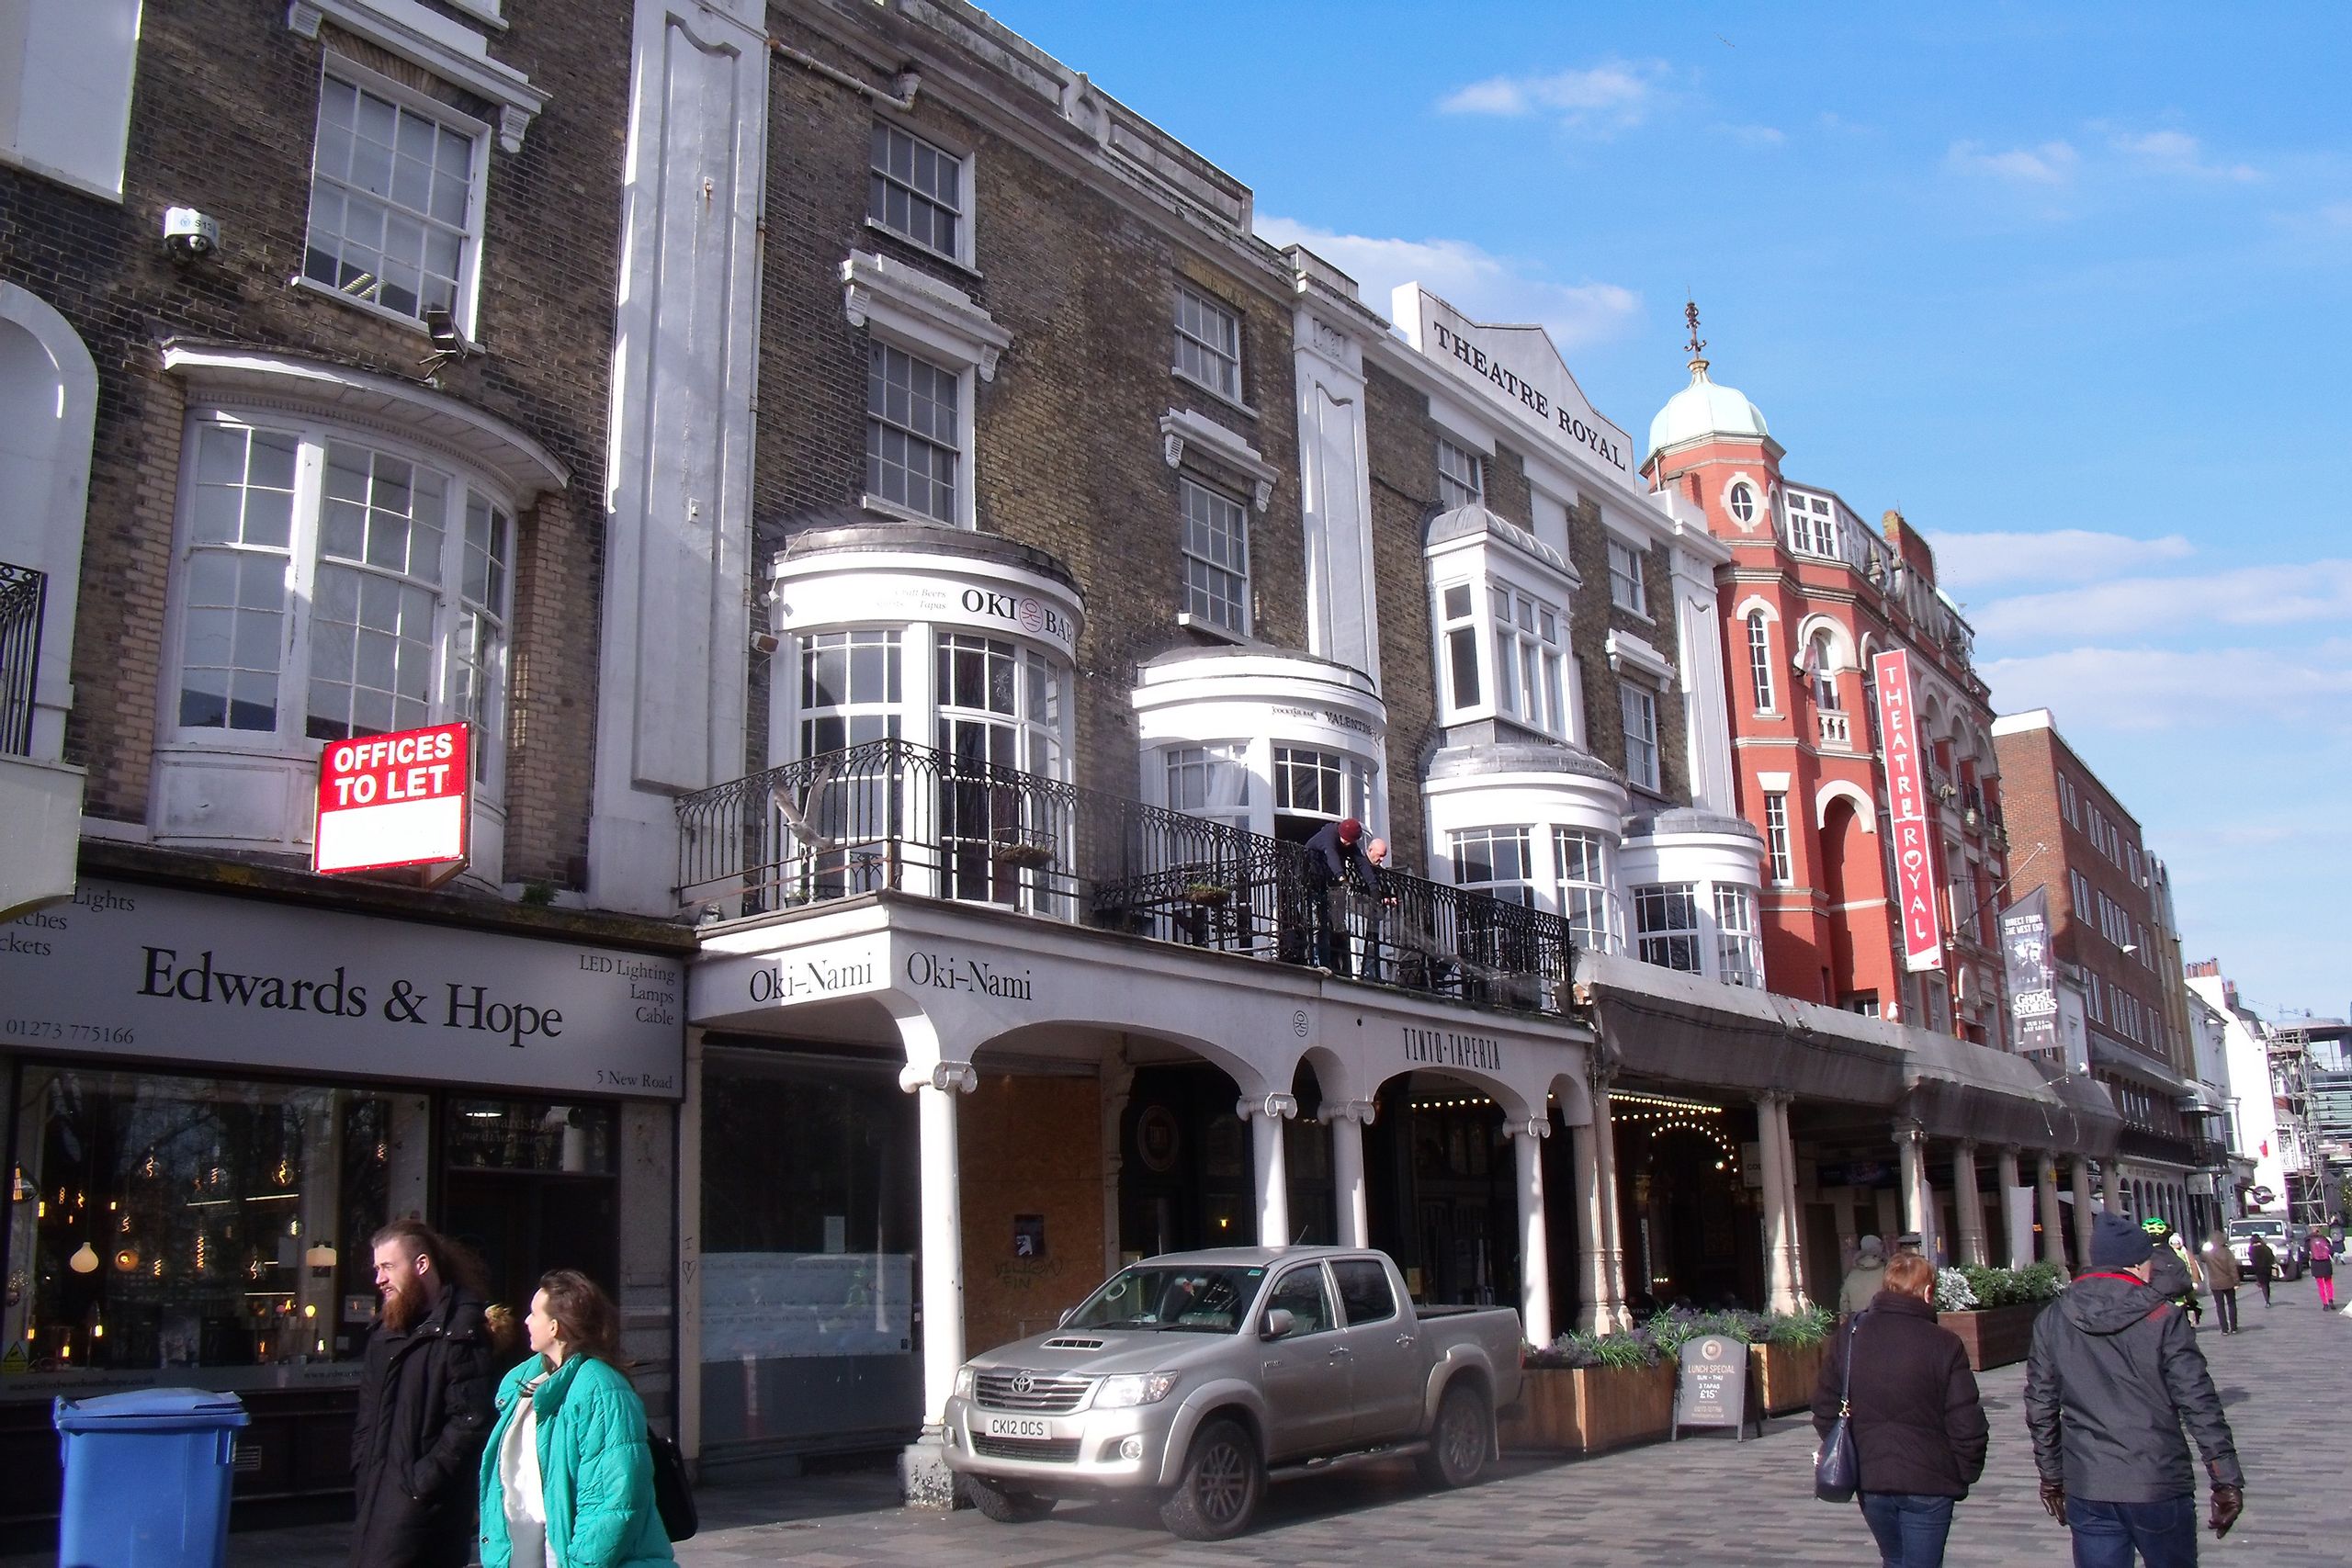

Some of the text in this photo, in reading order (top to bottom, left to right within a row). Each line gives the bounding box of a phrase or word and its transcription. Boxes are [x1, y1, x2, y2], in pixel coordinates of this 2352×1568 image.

[1433, 321, 1626, 472] THEATRE ROYAL
[922, 588, 946, 598] Beers
[920, 600, 946, 611] Tapas
[962, 589, 1072, 645] OKI BAR
[334, 732, 453, 773] OFFICES
[334, 764, 450, 807] TO LET
[1884, 666, 1927, 940] THEATRE ROYAL
[73, 887, 135, 912] Lights
[17, 912, 67, 930] tches
[2005, 914, 2041, 928] DIRECT FROM
[2005, 922, 2044, 935] THE WEST END
[0, 931, 51, 956] ckets
[580, 954, 675, 986] LED Lighting
[750, 953, 873, 1002] Oki-Nami
[907, 952, 1033, 1001] Oki-Nami
[136, 946, 563, 1048] Edwards & Hope
[630, 984, 674, 1007] Lamps
[2012, 998, 2058, 1015] STORIES
[2015, 989, 2052, 1005] GHOST
[636, 1007, 673, 1025] Cable
[6, 1020, 135, 1044] 01273 775166
[597, 1070, 673, 1089] 5 New Road
[1688, 1364, 1735, 1374] LUNCH SPECIAL
[992, 1419, 1044, 1436] CK12 OCS
